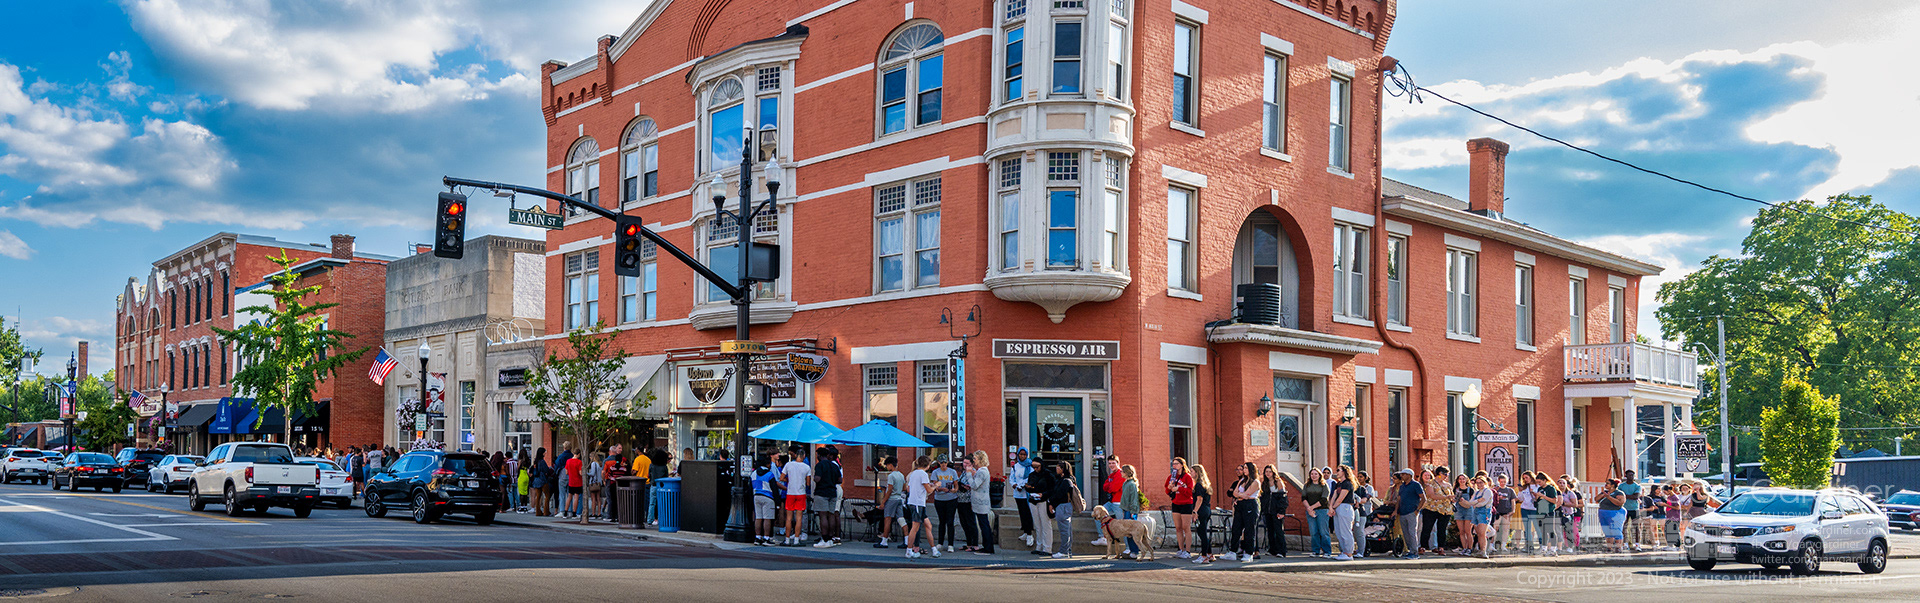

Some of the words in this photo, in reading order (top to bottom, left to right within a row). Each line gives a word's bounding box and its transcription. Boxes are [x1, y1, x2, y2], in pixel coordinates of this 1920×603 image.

[517, 212, 545, 226] MAIN
[547, 217, 556, 226] ST
[443, 281, 464, 296] BANK
[731, 343, 766, 351] UPTOW
[1005, 342, 1077, 356] ESPRESSO
[1080, 344, 1107, 356] AIR
[789, 354, 814, 365] Uptown
[687, 367, 714, 380] Uptown
[793, 363, 825, 374] pharmacy
[691, 379, 726, 391] pharmacy
[950, 364, 958, 442] COFFEE
[1679, 442, 1705, 451] ART
